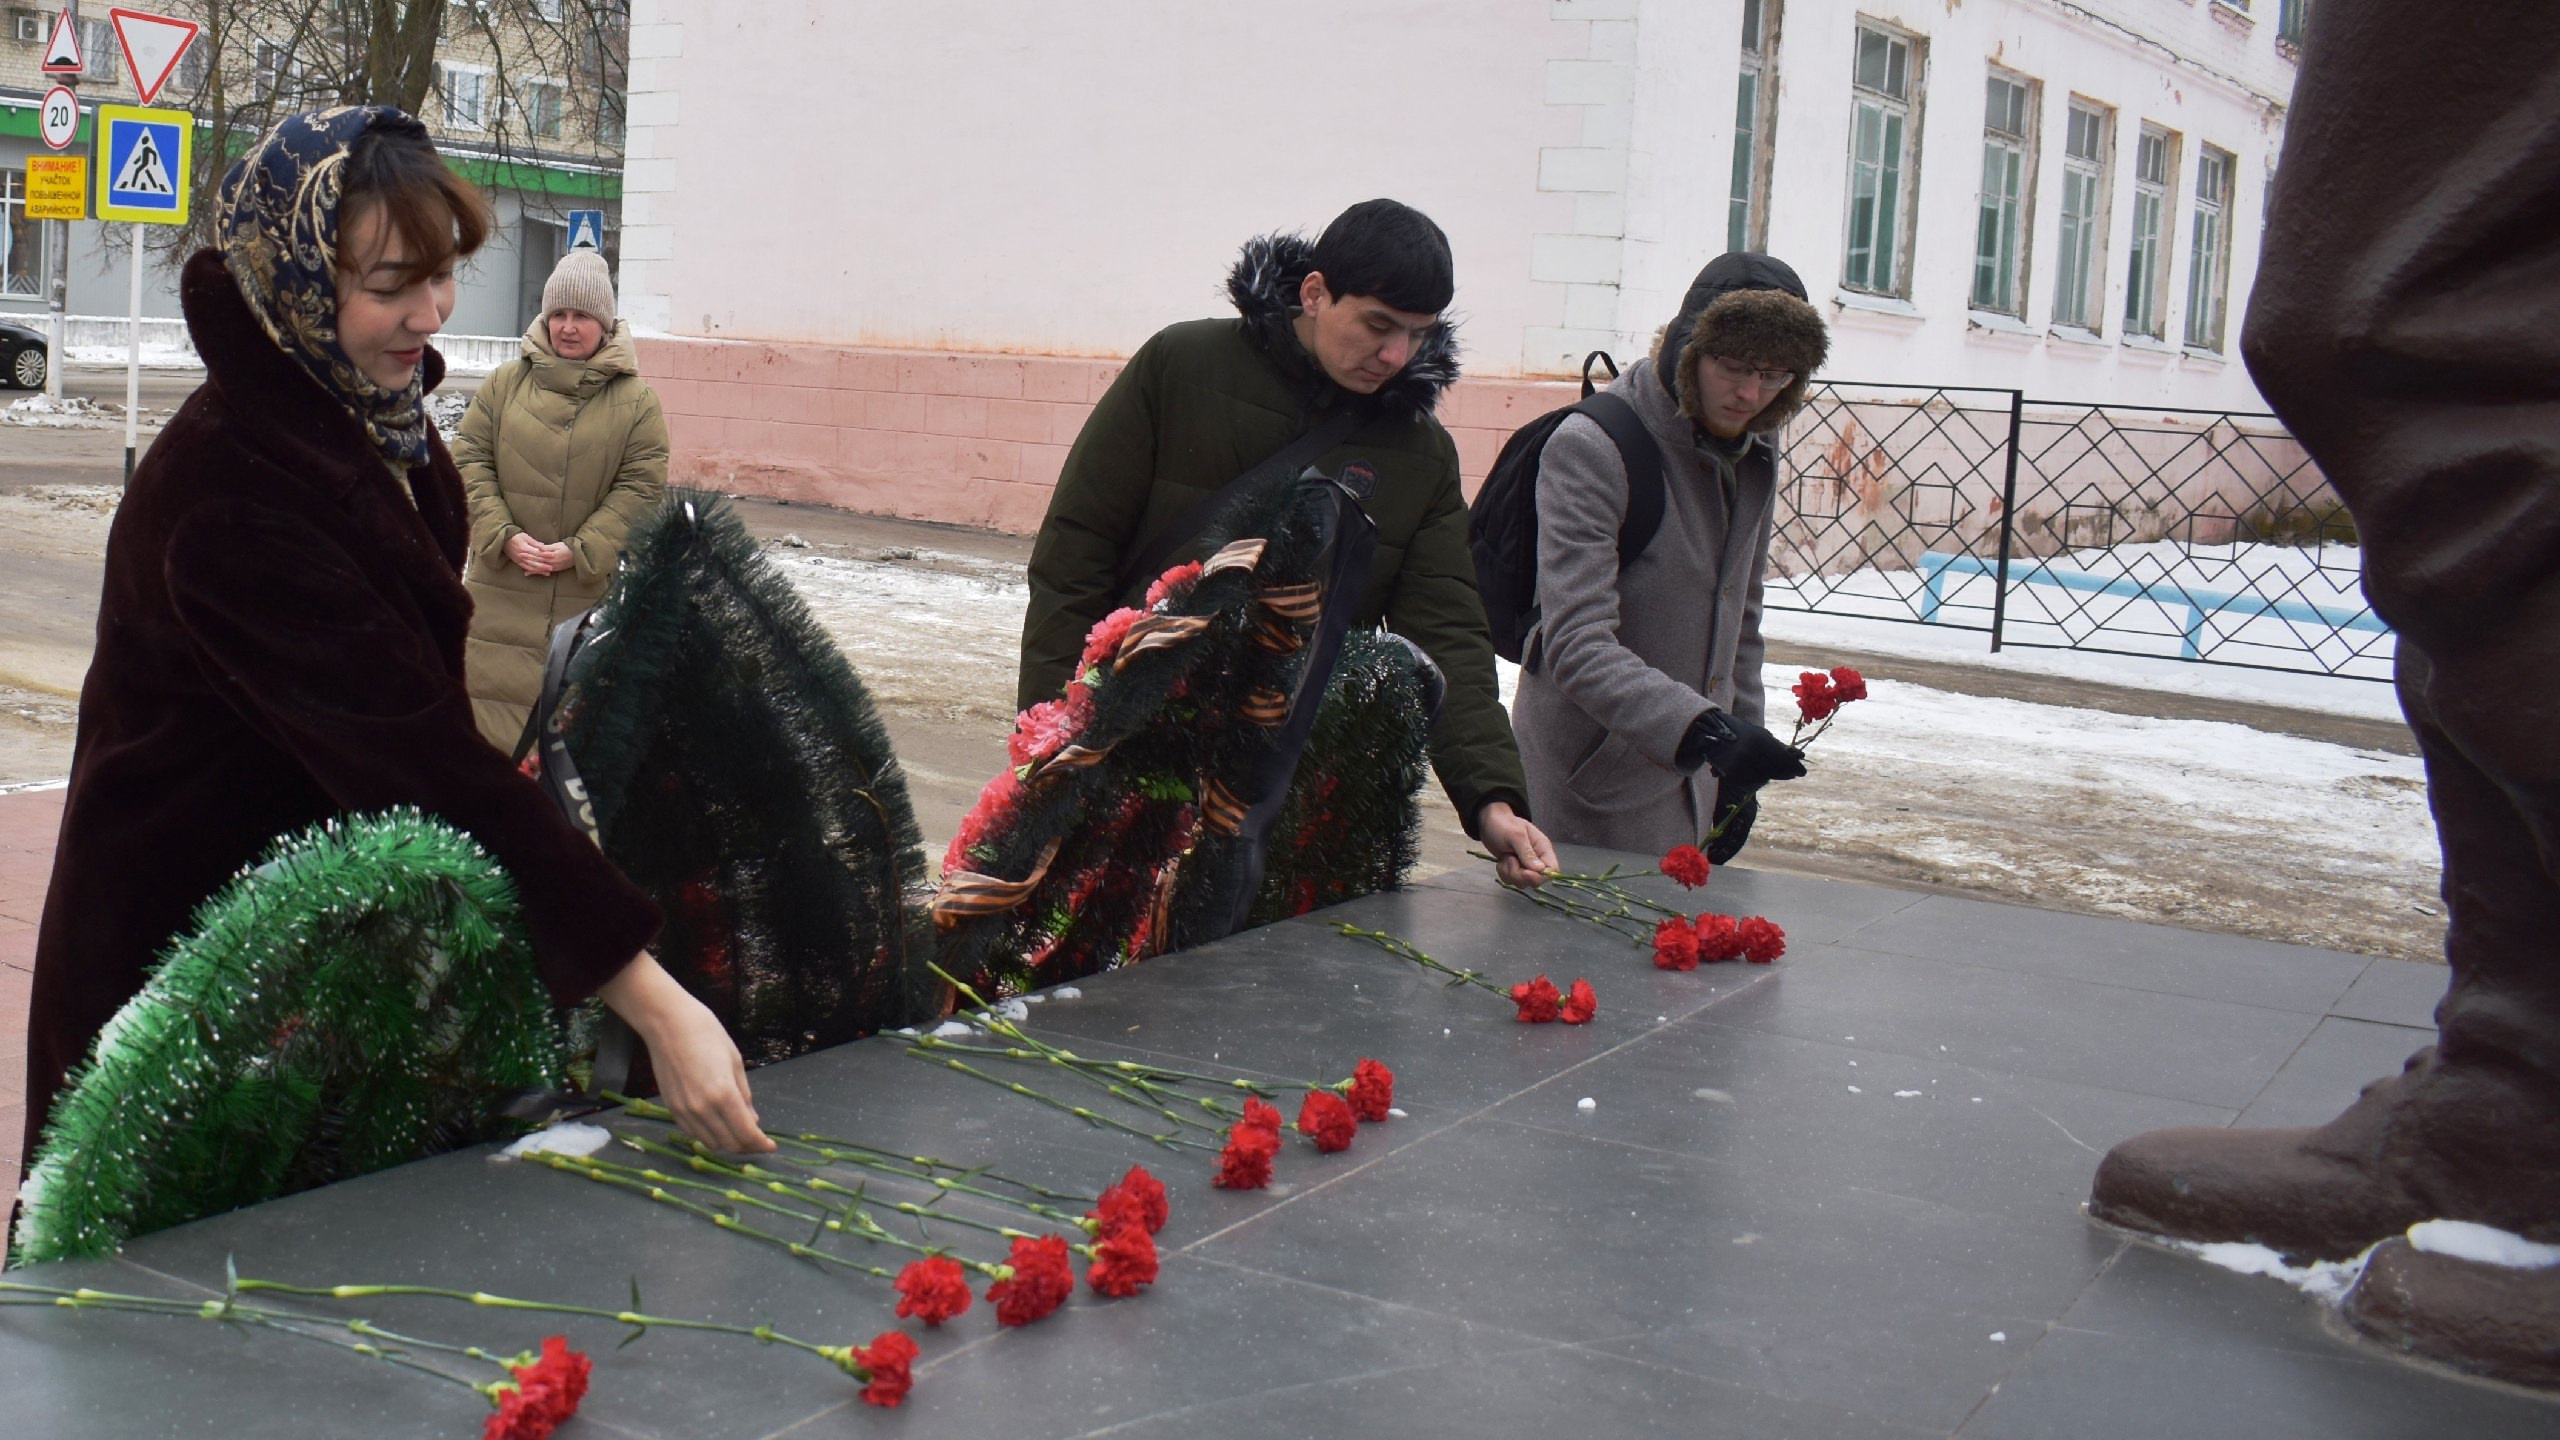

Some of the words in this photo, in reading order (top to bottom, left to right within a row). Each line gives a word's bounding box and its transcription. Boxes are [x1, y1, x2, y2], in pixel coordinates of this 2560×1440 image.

[50, 106, 69, 127] 20
[40, 175, 71, 185] УЧАСТОК
[30, 190, 81, 200] ПОВЫШЕННОЙ
[30, 204, 80, 215] АВАРИЙНОСТИ
